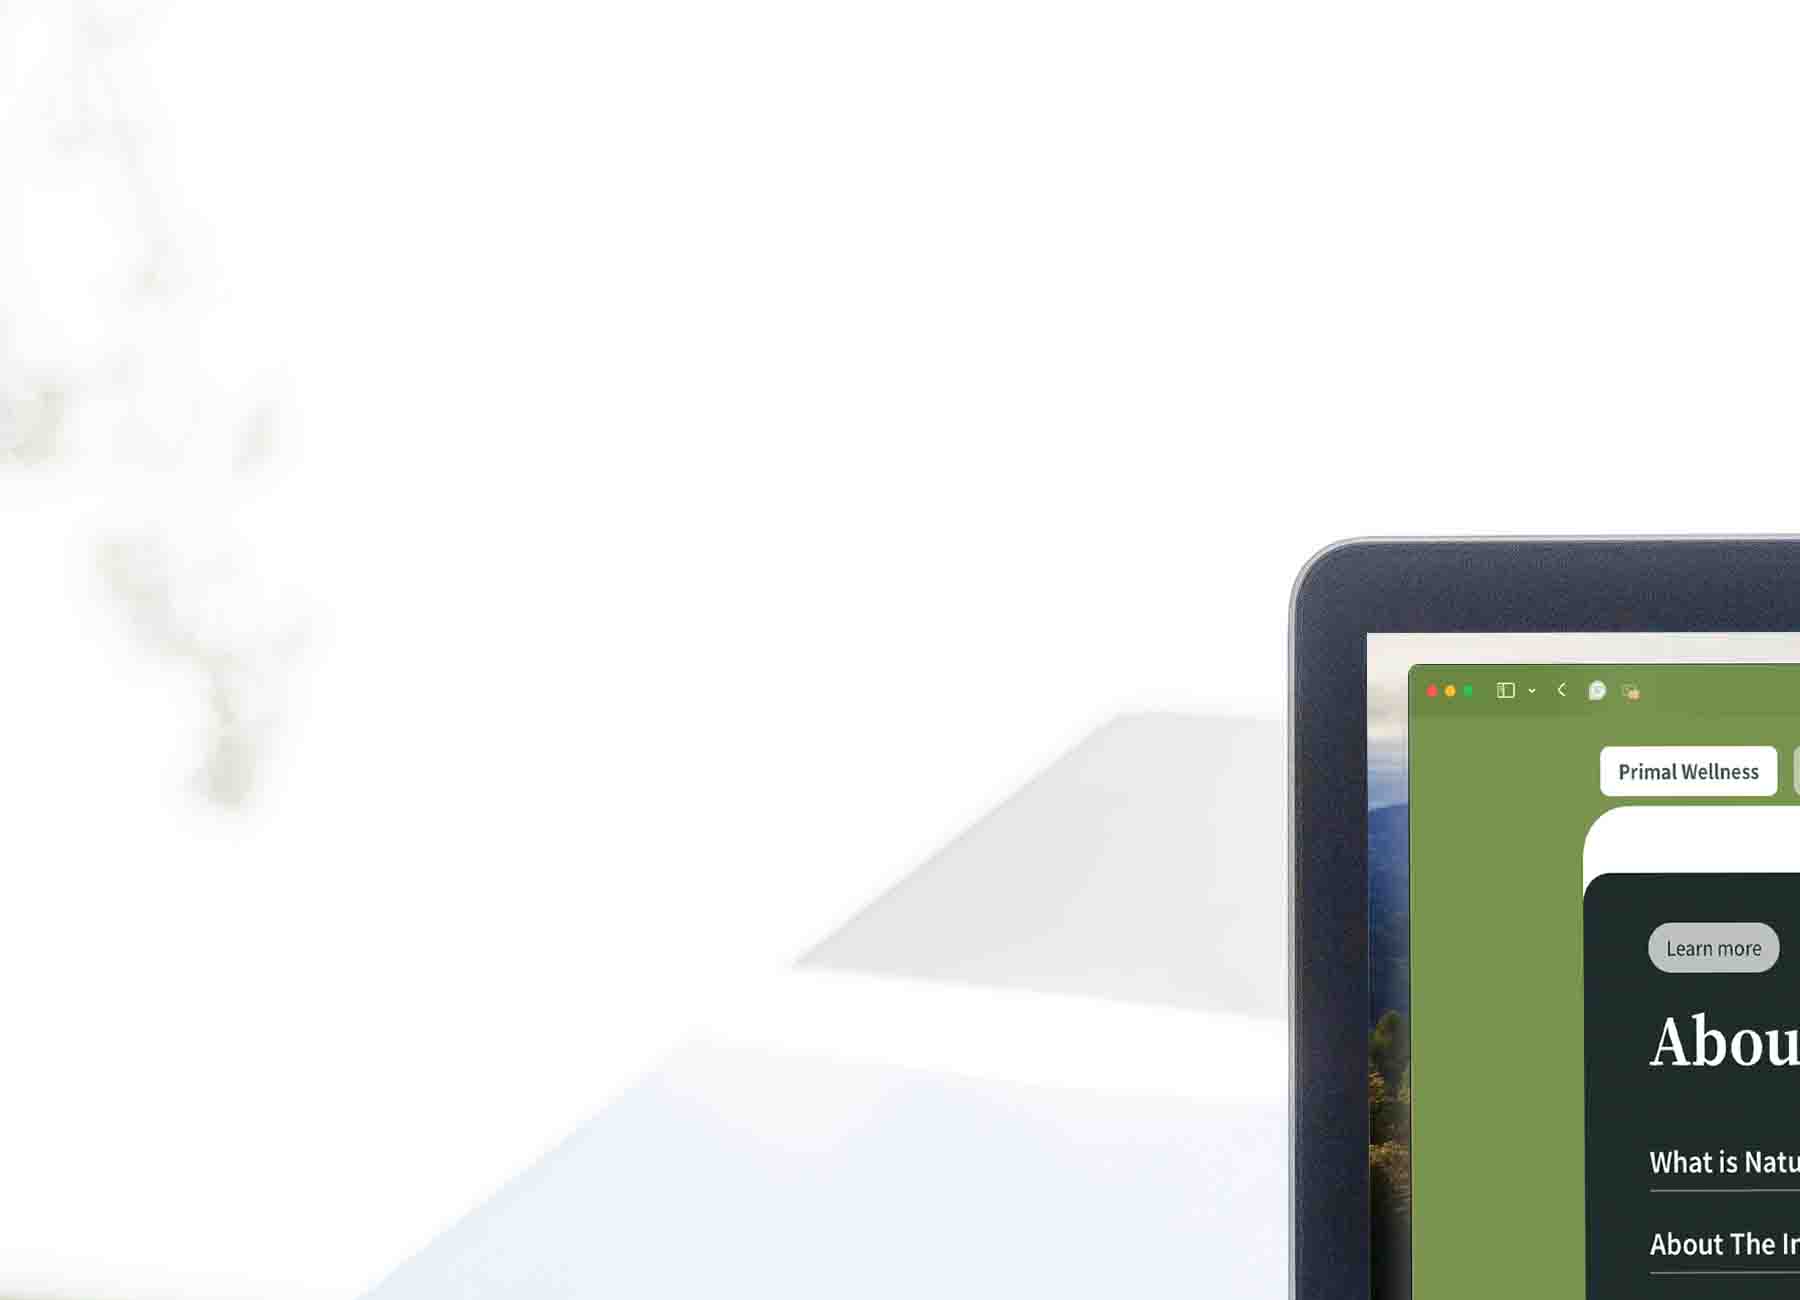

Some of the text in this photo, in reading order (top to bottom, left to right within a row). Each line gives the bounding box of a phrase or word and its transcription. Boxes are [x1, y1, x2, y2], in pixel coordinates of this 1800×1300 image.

[1619, 762, 1760, 781] Primal Wellness
[1667, 940, 1762, 957] Learn more
[1649, 1149, 1713, 1174] What
[1719, 1149, 1738, 1174] is
[1649, 1231, 1724, 1256] About
[1729, 1231, 1776, 1256] The
